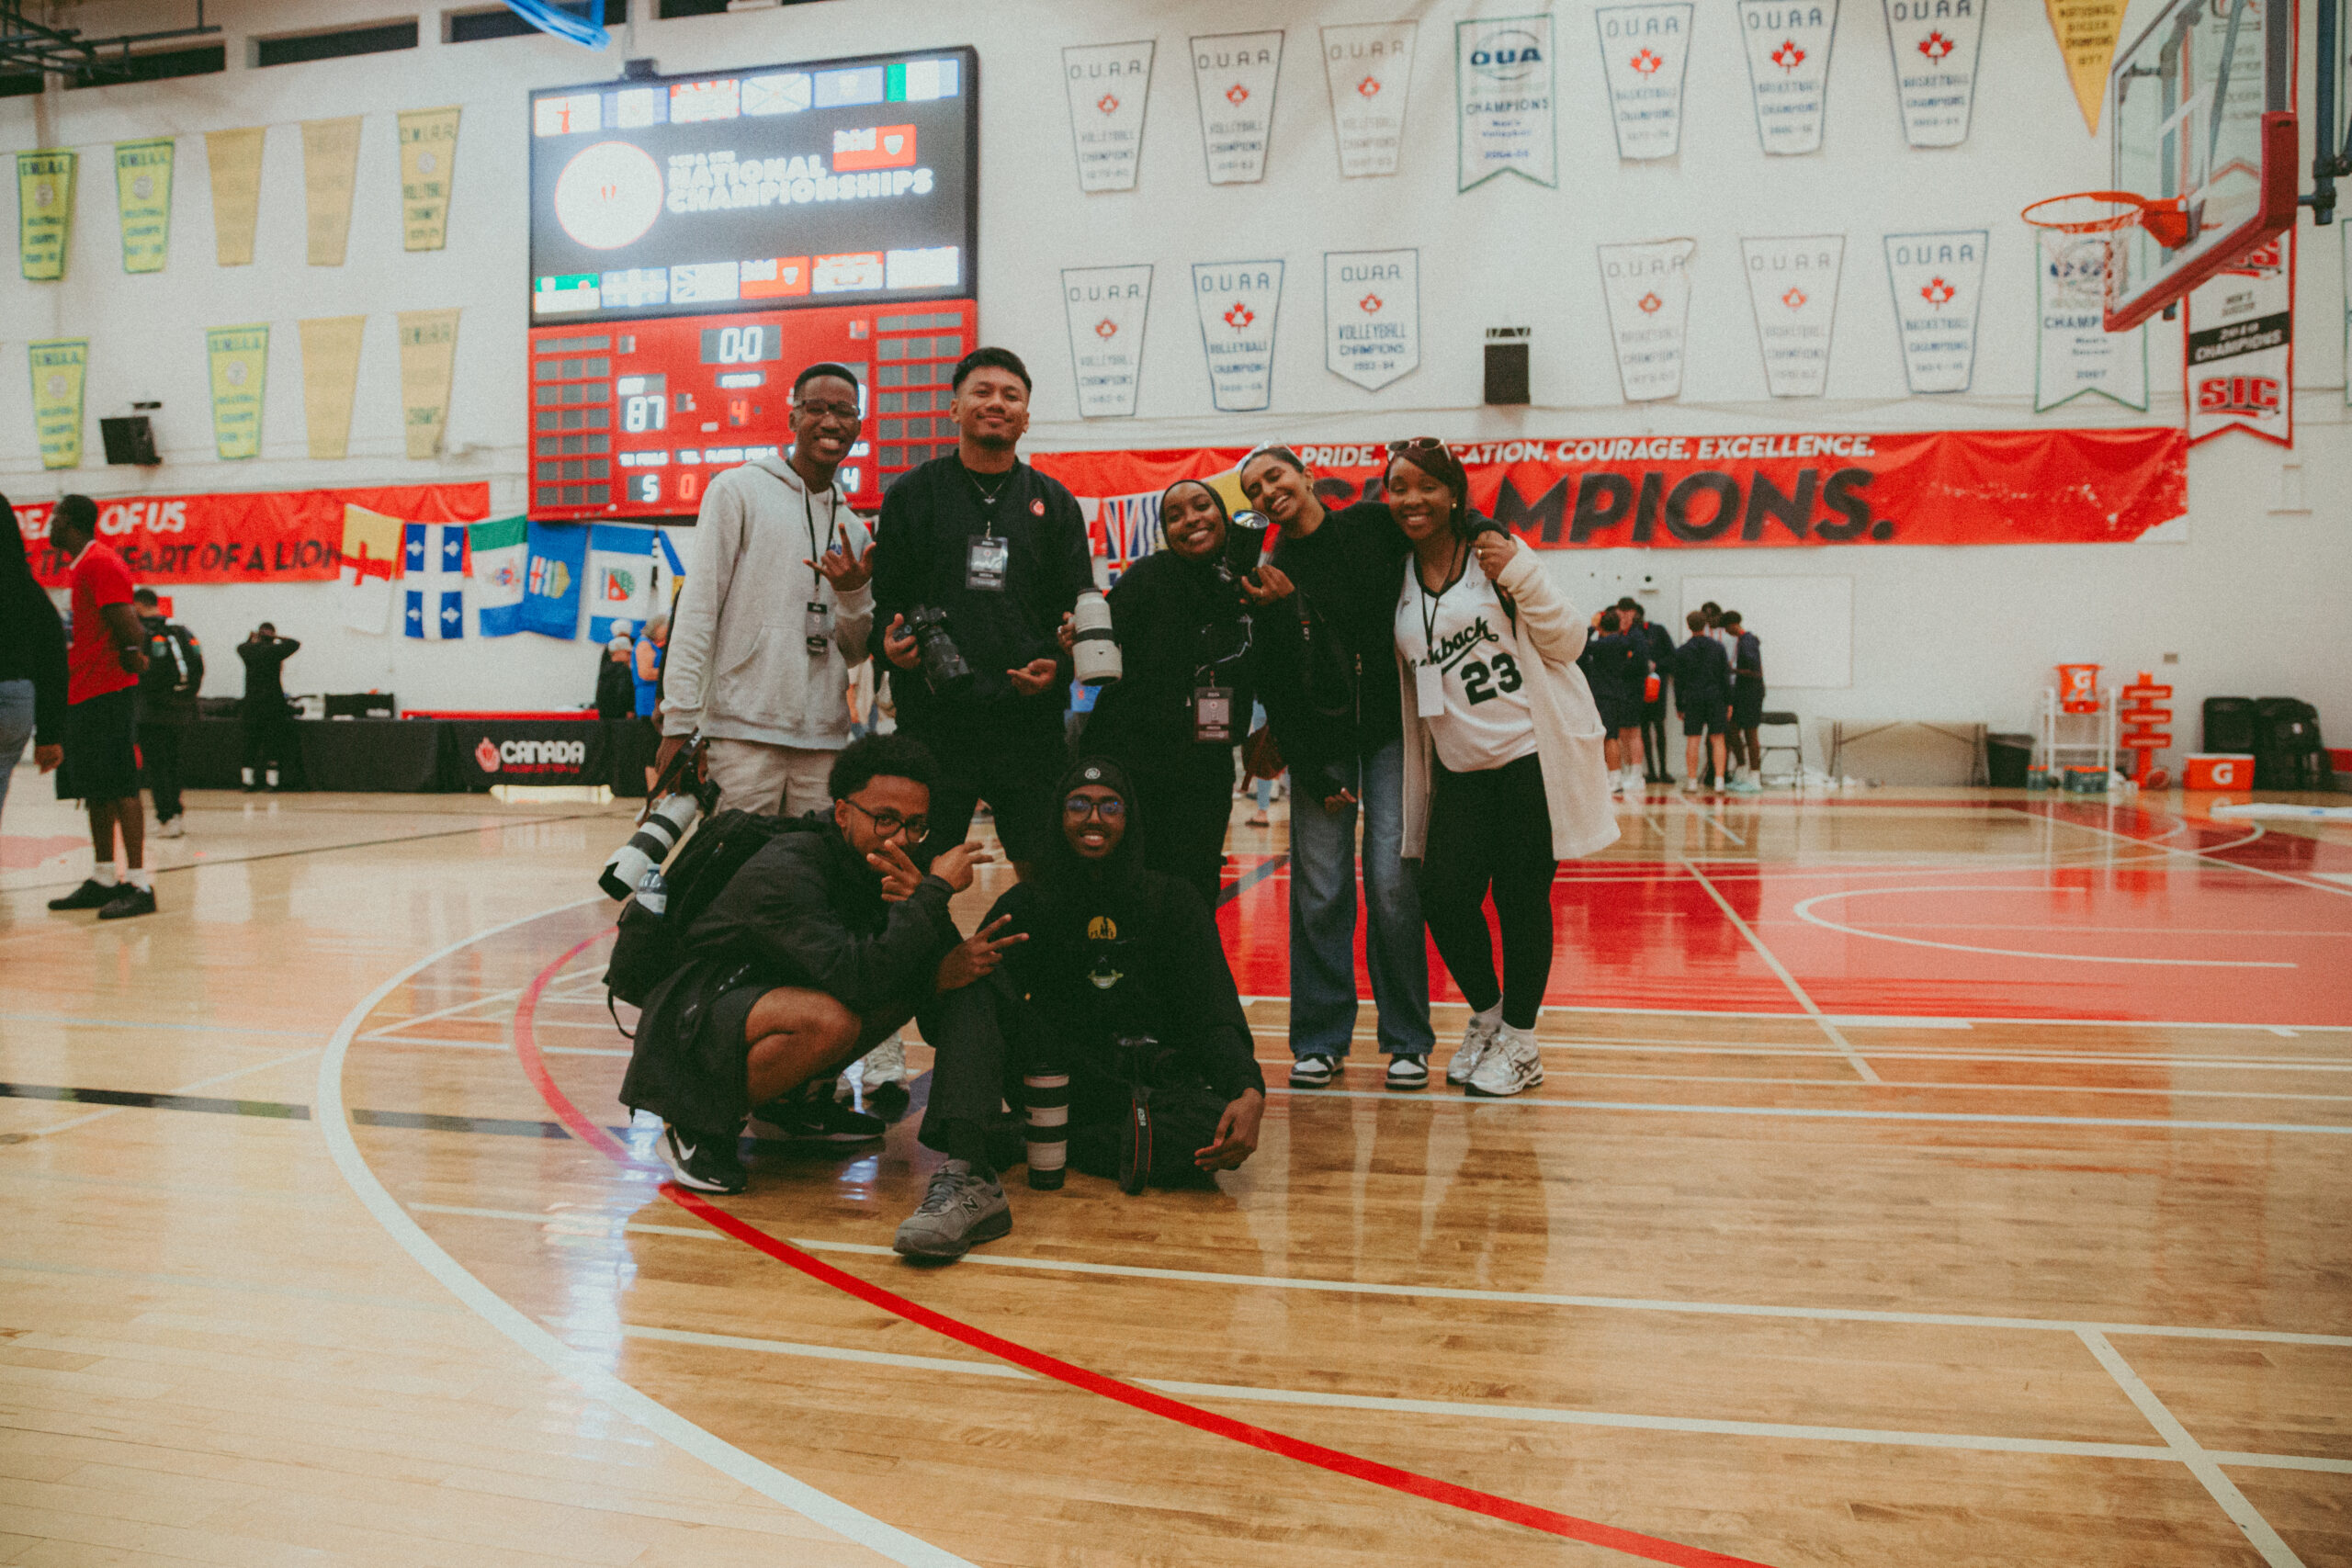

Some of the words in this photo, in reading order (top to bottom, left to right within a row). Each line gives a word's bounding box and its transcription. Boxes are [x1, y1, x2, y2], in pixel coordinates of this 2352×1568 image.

[1470, 47, 1543, 67] OUA
[1466, 98, 1549, 116] CHAMPIONS
[668, 153, 827, 188] NATIONAL
[666, 167, 933, 213] CHAMPIONSHIPS
[1339, 323, 1407, 341] VOLLEYBALL
[2043, 314, 2104, 331] CHAMP
[1210, 340, 1269, 355] VOLLEYBALL
[1339, 343, 1406, 356] CHAMPIONS
[2194, 329, 2284, 362] CHAMPIONS
[2199, 375, 2280, 410] SIC
[626, 395, 666, 433] 87
[730, 399, 747, 425] 4
[1301, 446, 1381, 468] PRIDE.
[1452, 441, 1550, 464] CATION.
[1556, 438, 1691, 463] COURAGE.
[1696, 434, 1876, 460] EXCELLENCE.
[641, 474, 660, 502] 5
[679, 474, 695, 500] 0
[841, 466, 861, 492] 4
[1313, 467, 1894, 543] MPIONS.
[98, 503, 143, 536] OF
[145, 501, 187, 534] US
[118, 544, 196, 574] EART
[199, 542, 242, 572] OF
[245, 543, 266, 572] A
[1460, 652, 1522, 705] 23
[2073, 670, 2091, 690] G
[500, 739, 586, 765] CANADA
[2211, 762, 2233, 785] G
[960, 1195, 979, 1216] N
